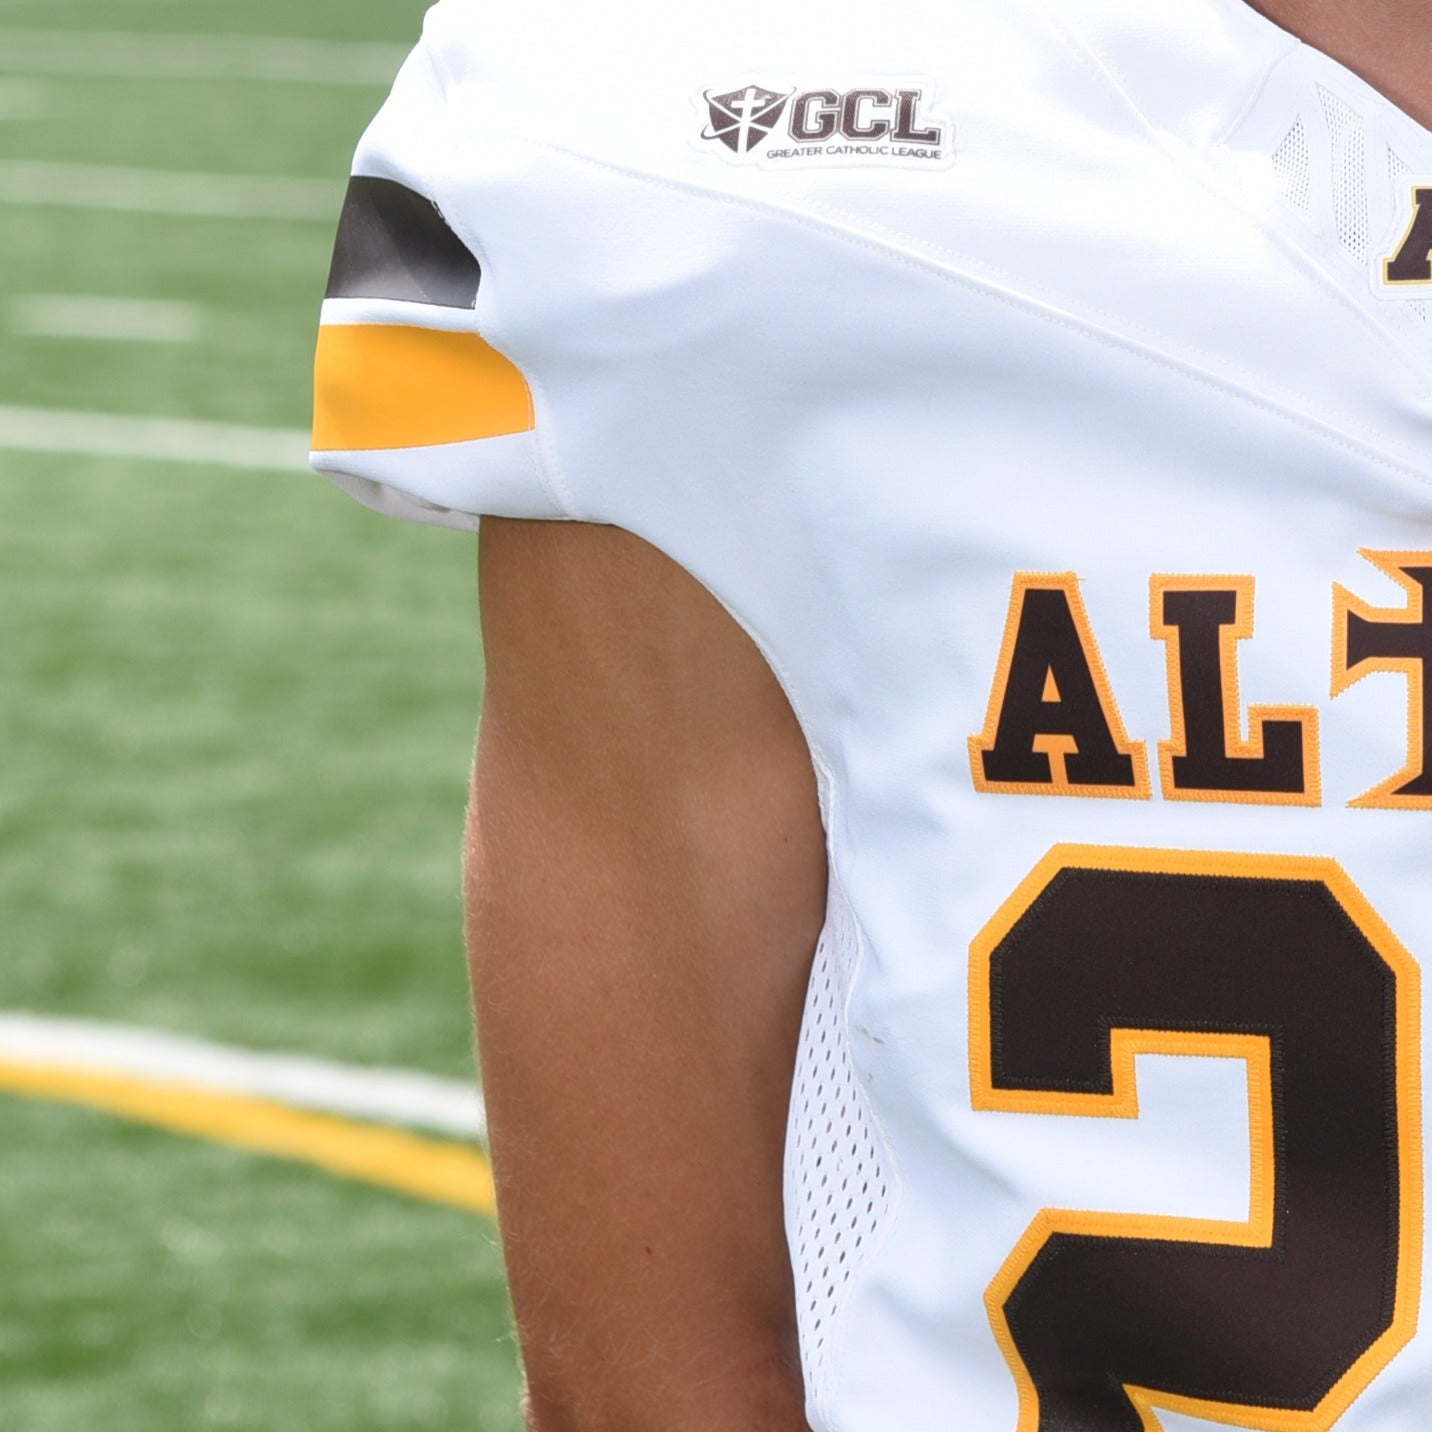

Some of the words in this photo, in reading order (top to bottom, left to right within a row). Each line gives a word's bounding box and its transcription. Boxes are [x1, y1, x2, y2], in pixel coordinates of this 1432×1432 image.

[788, 88, 941, 145] GCL
[767, 146, 823, 159] GREATER
[826, 145, 888, 156] CATHOLIC
[891, 147, 942, 160] LEAGUE
